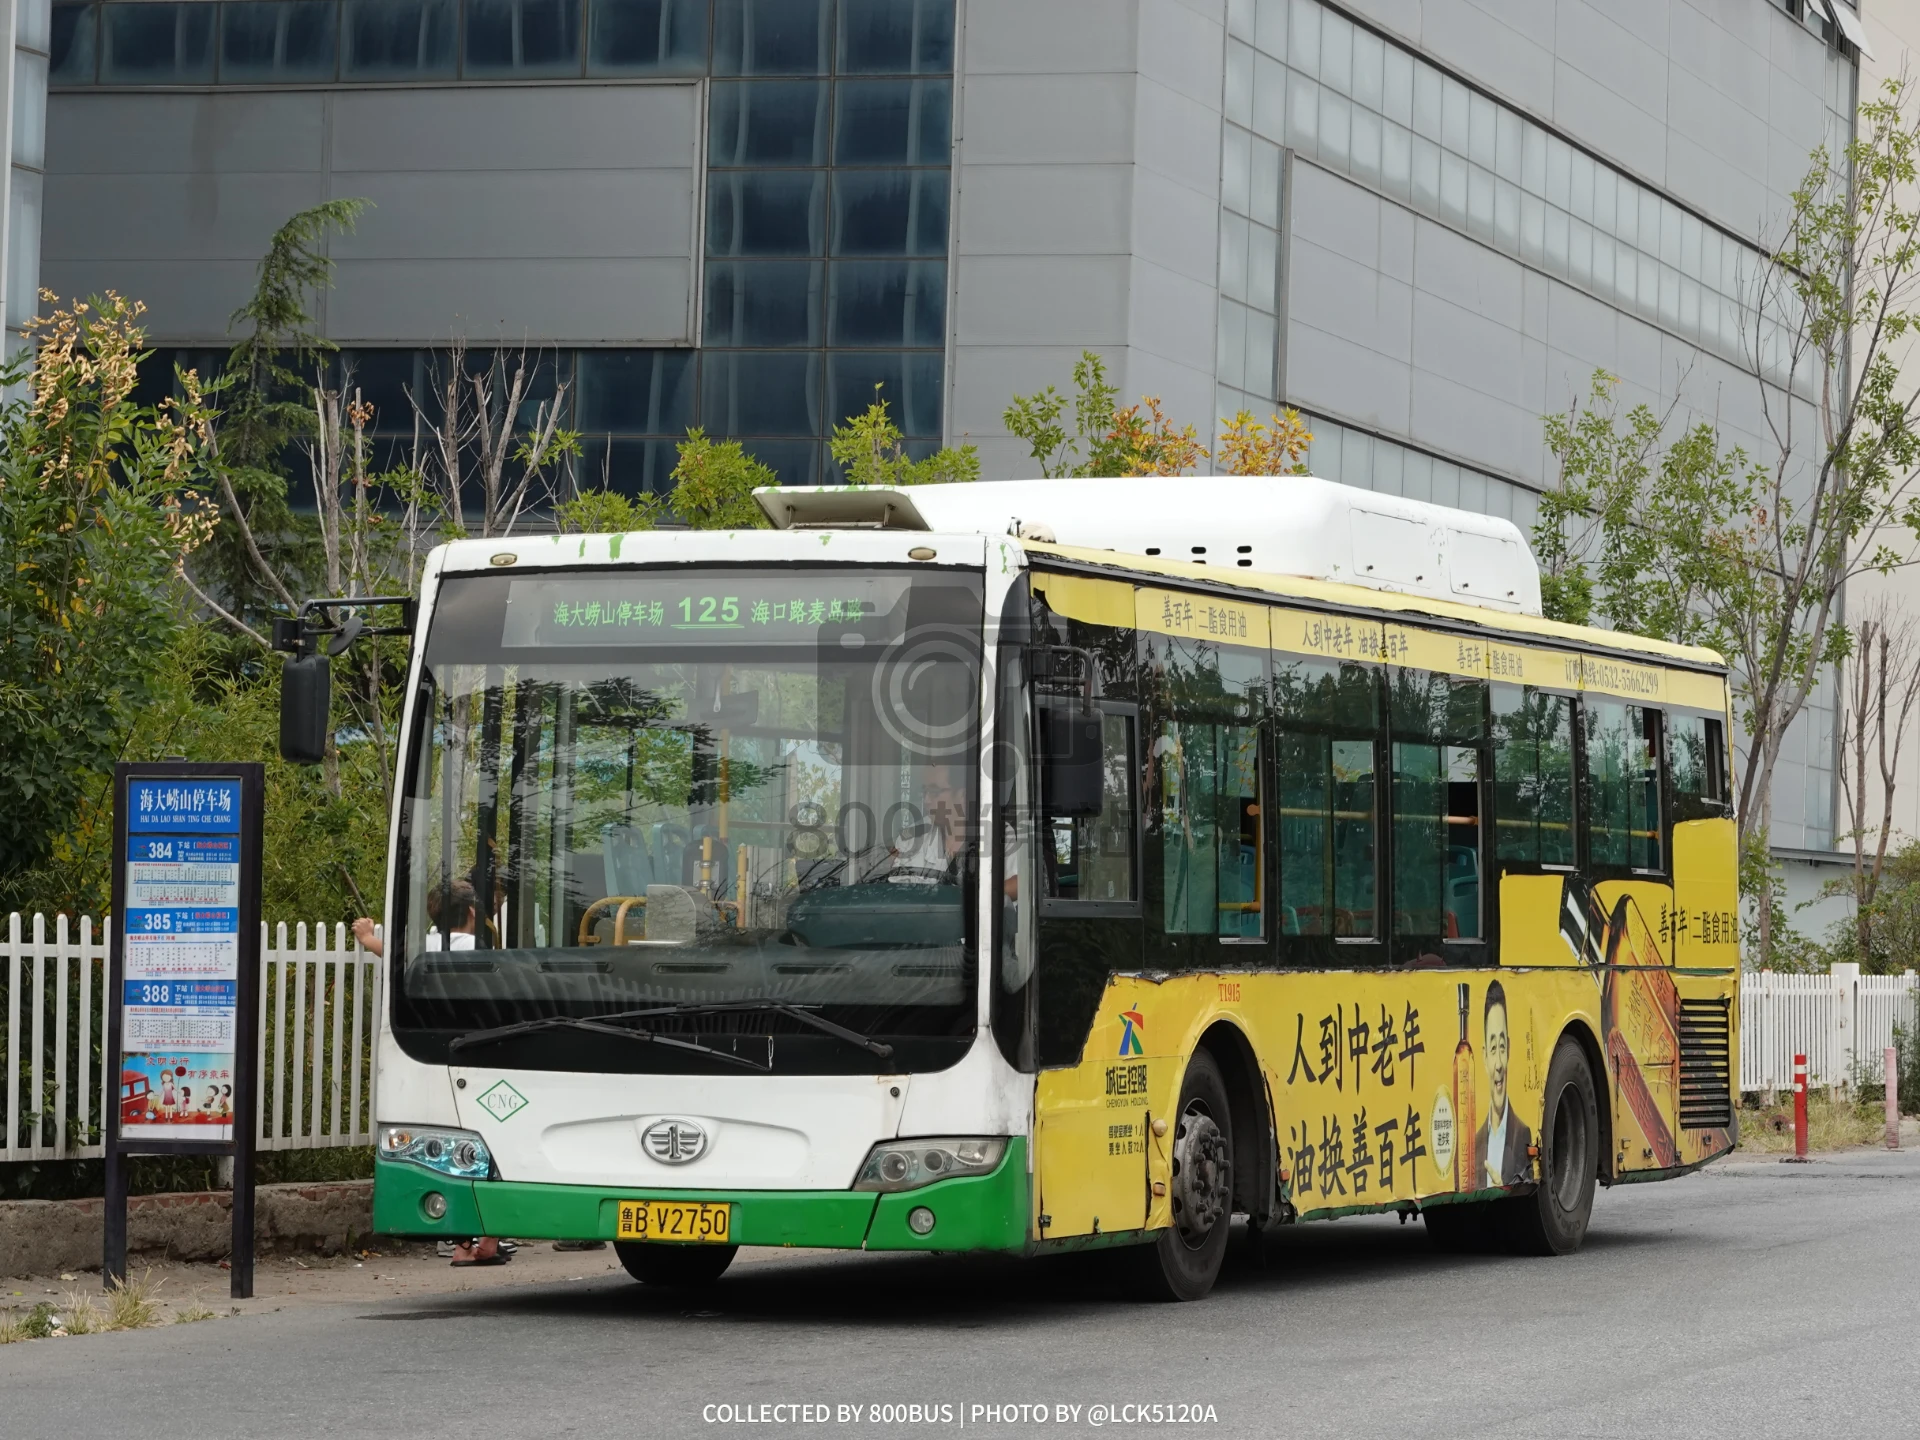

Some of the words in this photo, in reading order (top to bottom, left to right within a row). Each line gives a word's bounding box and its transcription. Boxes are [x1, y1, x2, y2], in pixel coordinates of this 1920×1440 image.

[553, 599, 664, 627] 海大崂山停车场
[677, 596, 740, 623] 125
[1161, 594, 1193, 632] 善百年
[1198, 606, 1247, 638] 二酯食用油
[1302, 619, 1353, 656] 人到中老年
[1457, 640, 1482, 673] 善百年
[140, 788, 231, 812] 海大崂山停车场
[140, 815, 150, 823] HAI
[151, 815, 159, 823] DA
[160, 815, 171, 823] LAO
[172, 815, 186, 823] SHAN
[188, 815, 200, 823] TING
[201, 815, 212, 823] CHE
[213, 815, 231, 823] CHANG
[148, 841, 173, 859] 384
[144, 913, 171, 930] 385
[142, 984, 169, 1003] 388
[1217, 983, 1241, 1002] T1915
[1286, 1000, 1426, 1094] 人到中老年
[146, 1056, 190, 1067] 文明出行
[187, 1069, 230, 1080] 有序乘车
[1105, 1064, 1148, 1096] 城运控股
[487, 1093, 518, 1110] CNG
[1105, 1098, 1129, 1108] CHENGYUN
[1130, 1096, 1149, 1106] HOLDING
[1287, 1103, 1427, 1200] 油换善百年
